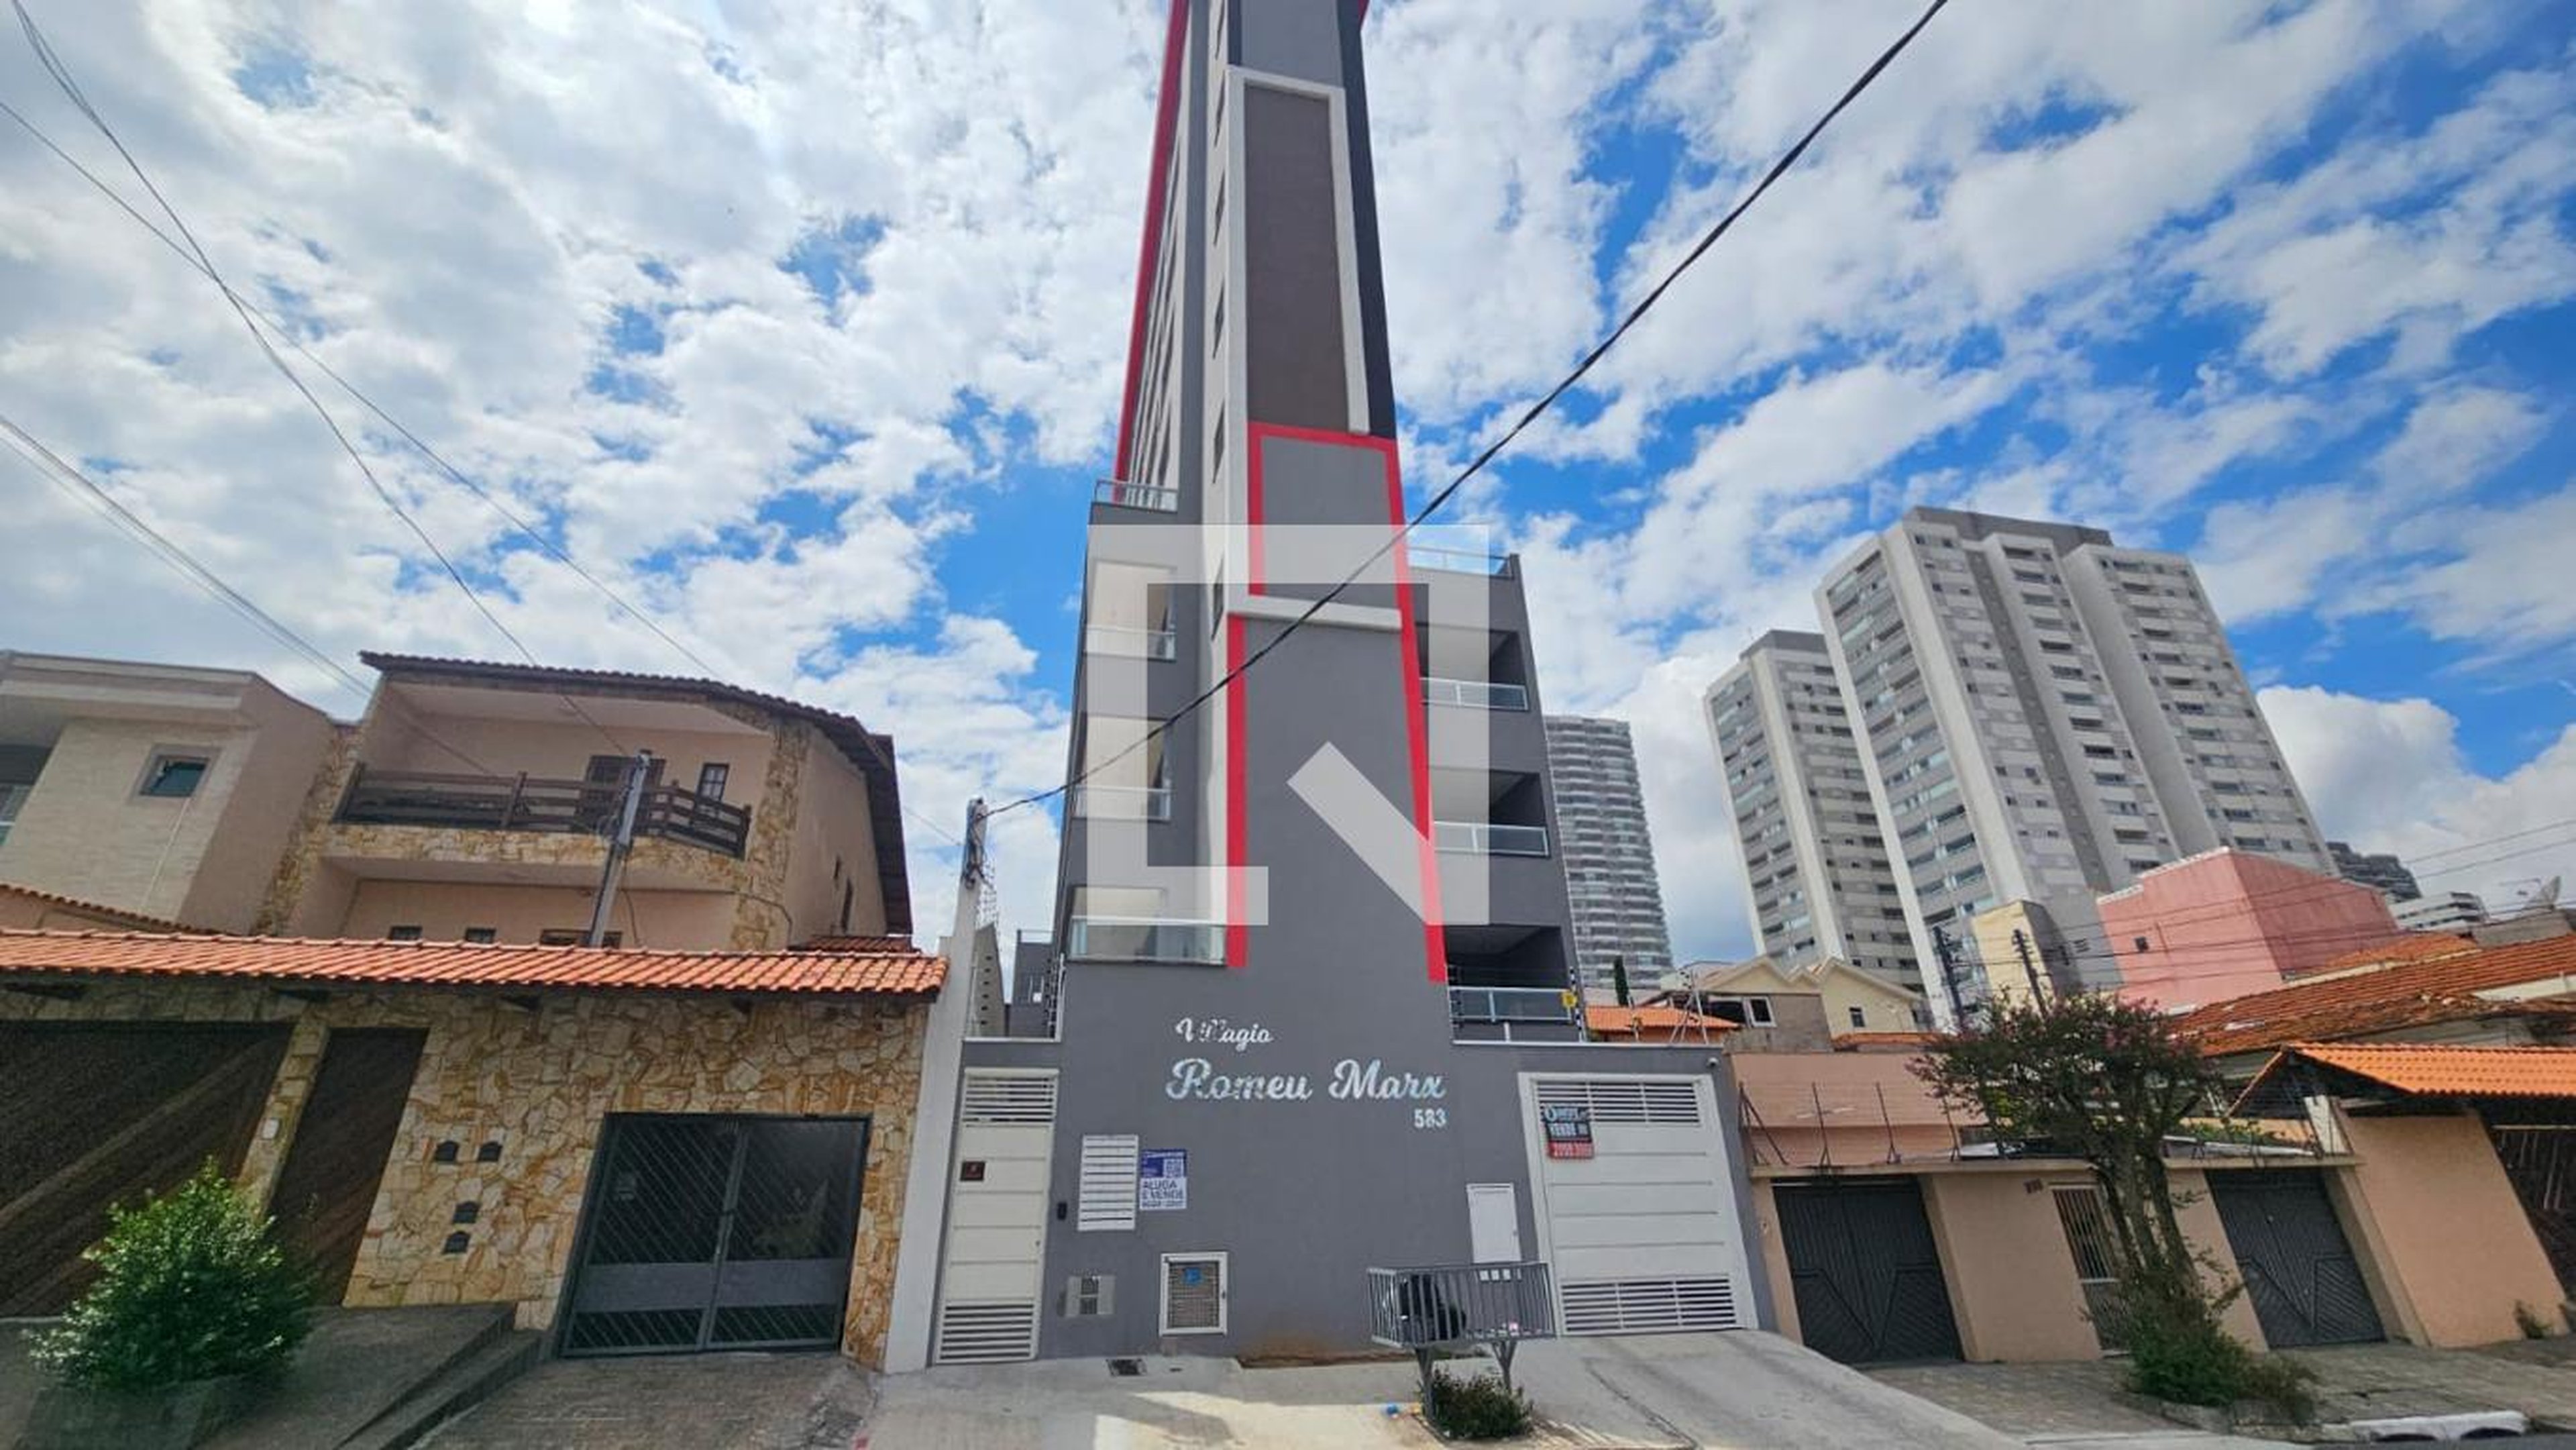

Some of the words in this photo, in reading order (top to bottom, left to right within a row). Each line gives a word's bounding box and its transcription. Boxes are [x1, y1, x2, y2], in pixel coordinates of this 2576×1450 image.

[1166, 1058, 1313, 1100] Romeu
[1328, 1059, 1446, 1100] Marx
[1413, 1108, 1448, 1129] 583
